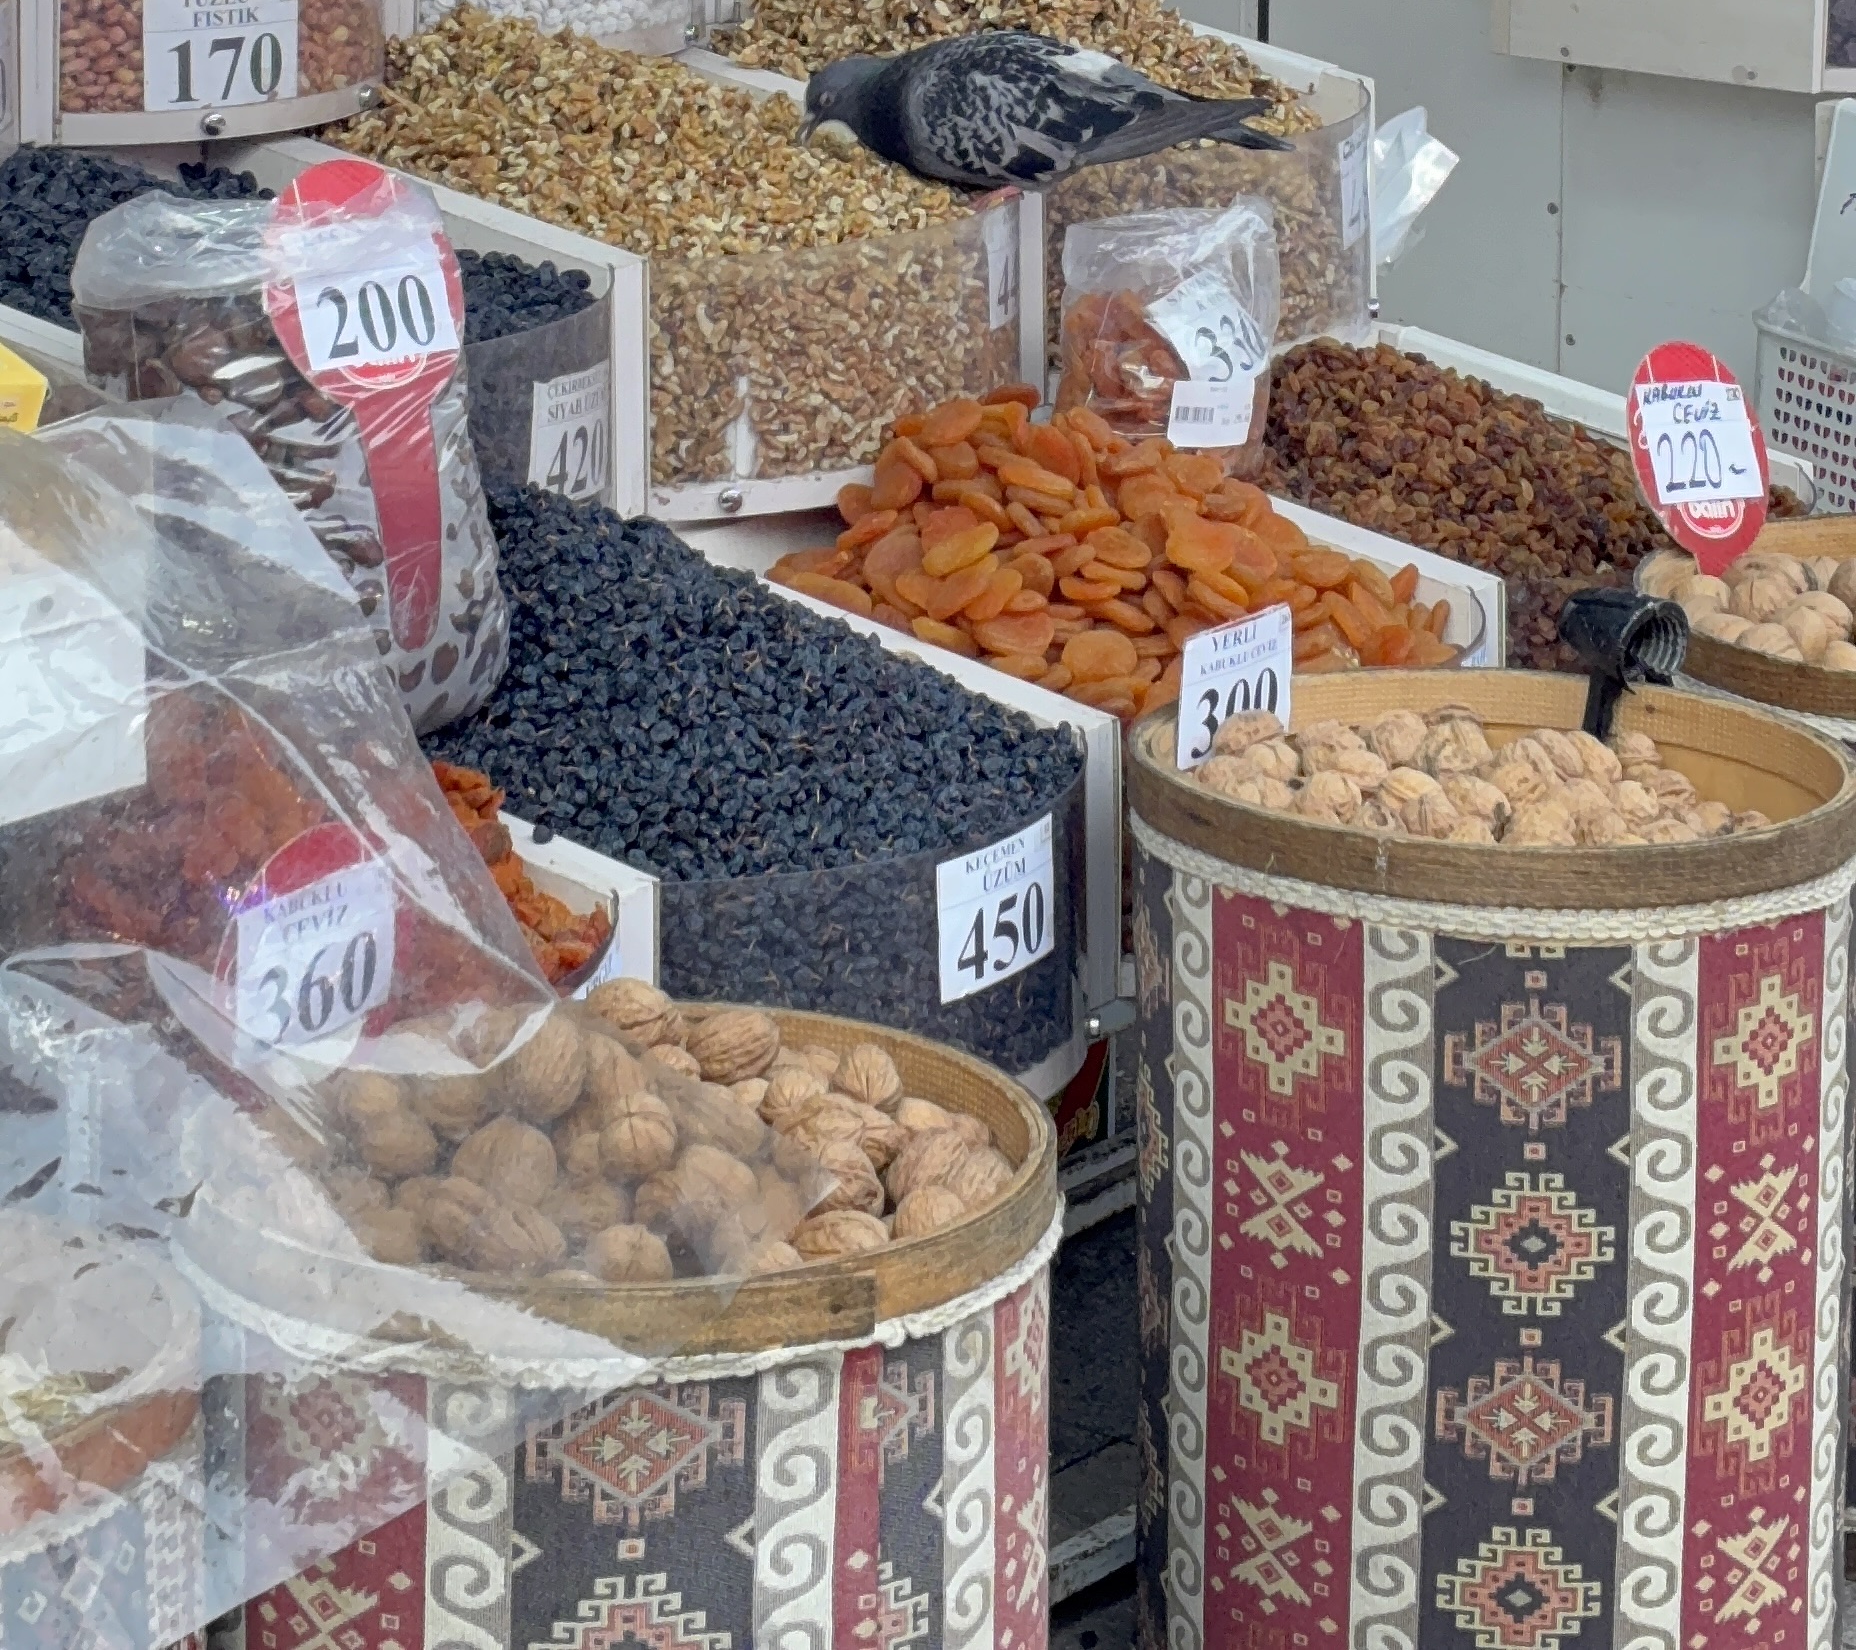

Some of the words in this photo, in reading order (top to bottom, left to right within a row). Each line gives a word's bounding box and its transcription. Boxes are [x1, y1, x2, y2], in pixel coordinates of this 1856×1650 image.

[193, 5, 259, 28] FISTIK
[168, 32, 284, 105] 170
[316, 274, 437, 360] 200
[546, 418, 605, 495] 420
[1657, 428, 1722, 493] 220
[1212, 621, 1257, 652] YERLİ
[1191, 666, 1279, 759] 300
[956, 881, 1044, 980] 450
[255, 931, 378, 1045] 360
